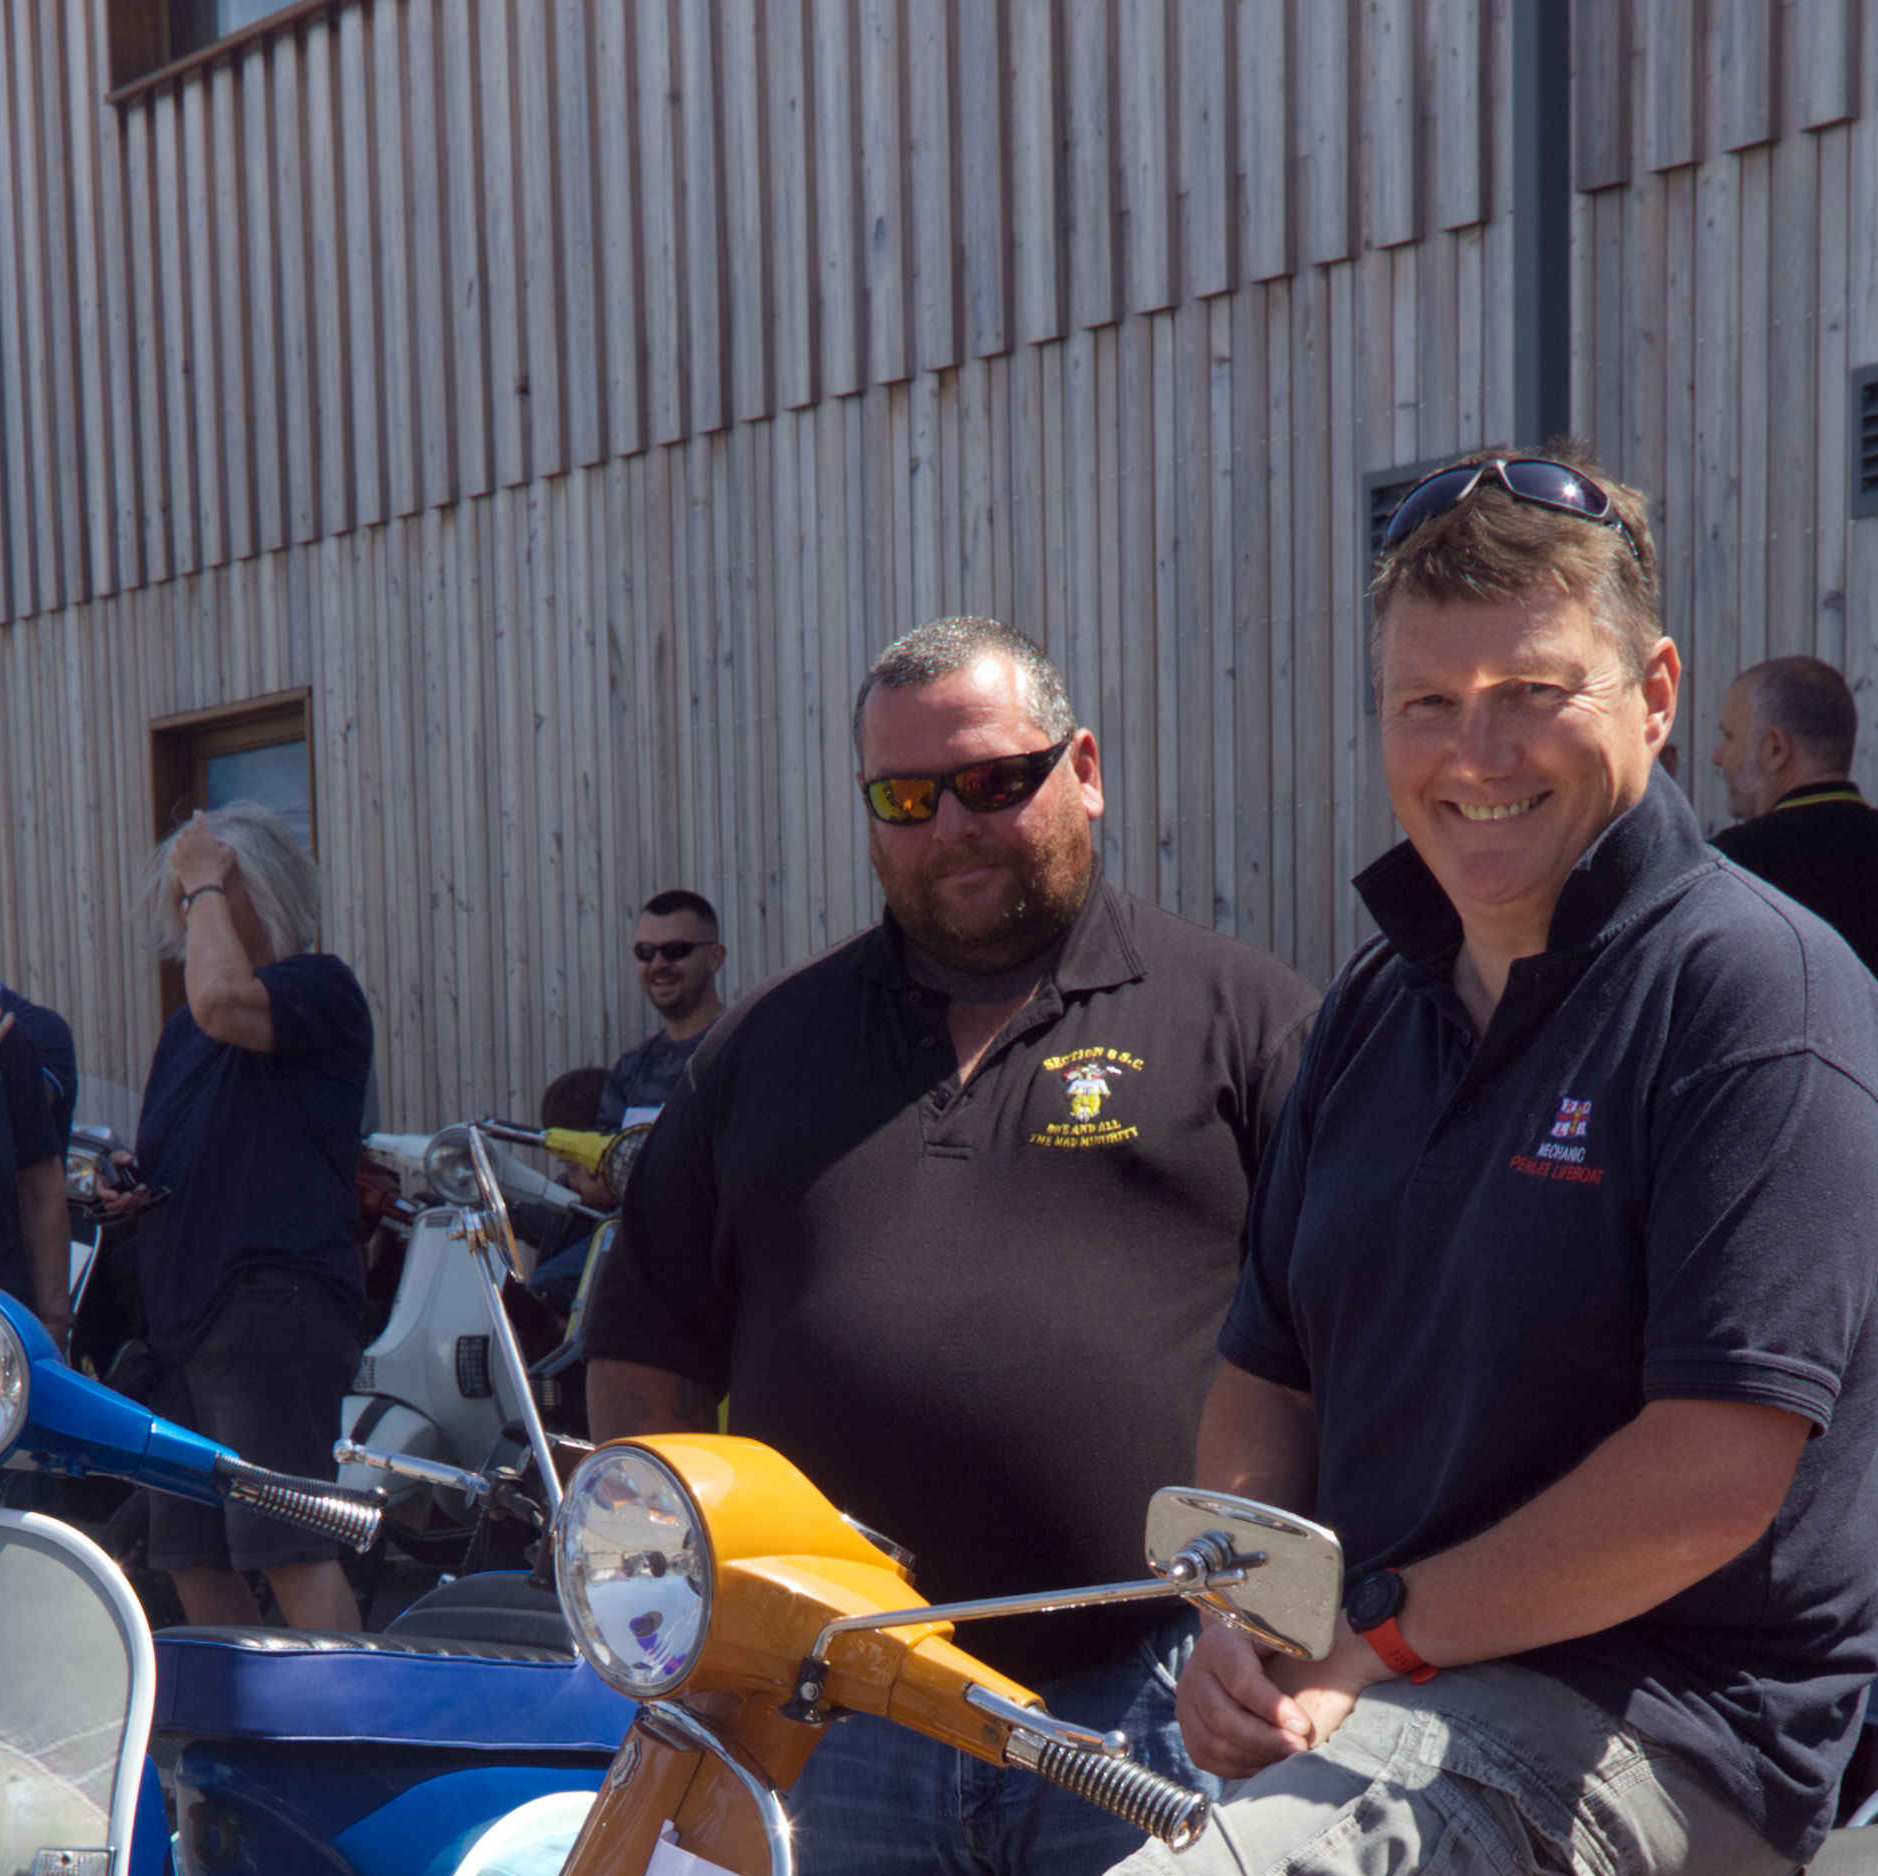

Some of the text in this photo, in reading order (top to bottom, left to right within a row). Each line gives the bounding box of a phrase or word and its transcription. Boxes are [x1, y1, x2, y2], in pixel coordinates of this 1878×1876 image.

[1042, 1046, 1105, 1072] SECTION
[1046, 1119, 1121, 1136] ONE AND ALL
[1537, 1143, 1586, 1163] MECHANIC
[1551, 1164, 1606, 1185] LIFEBOAT
